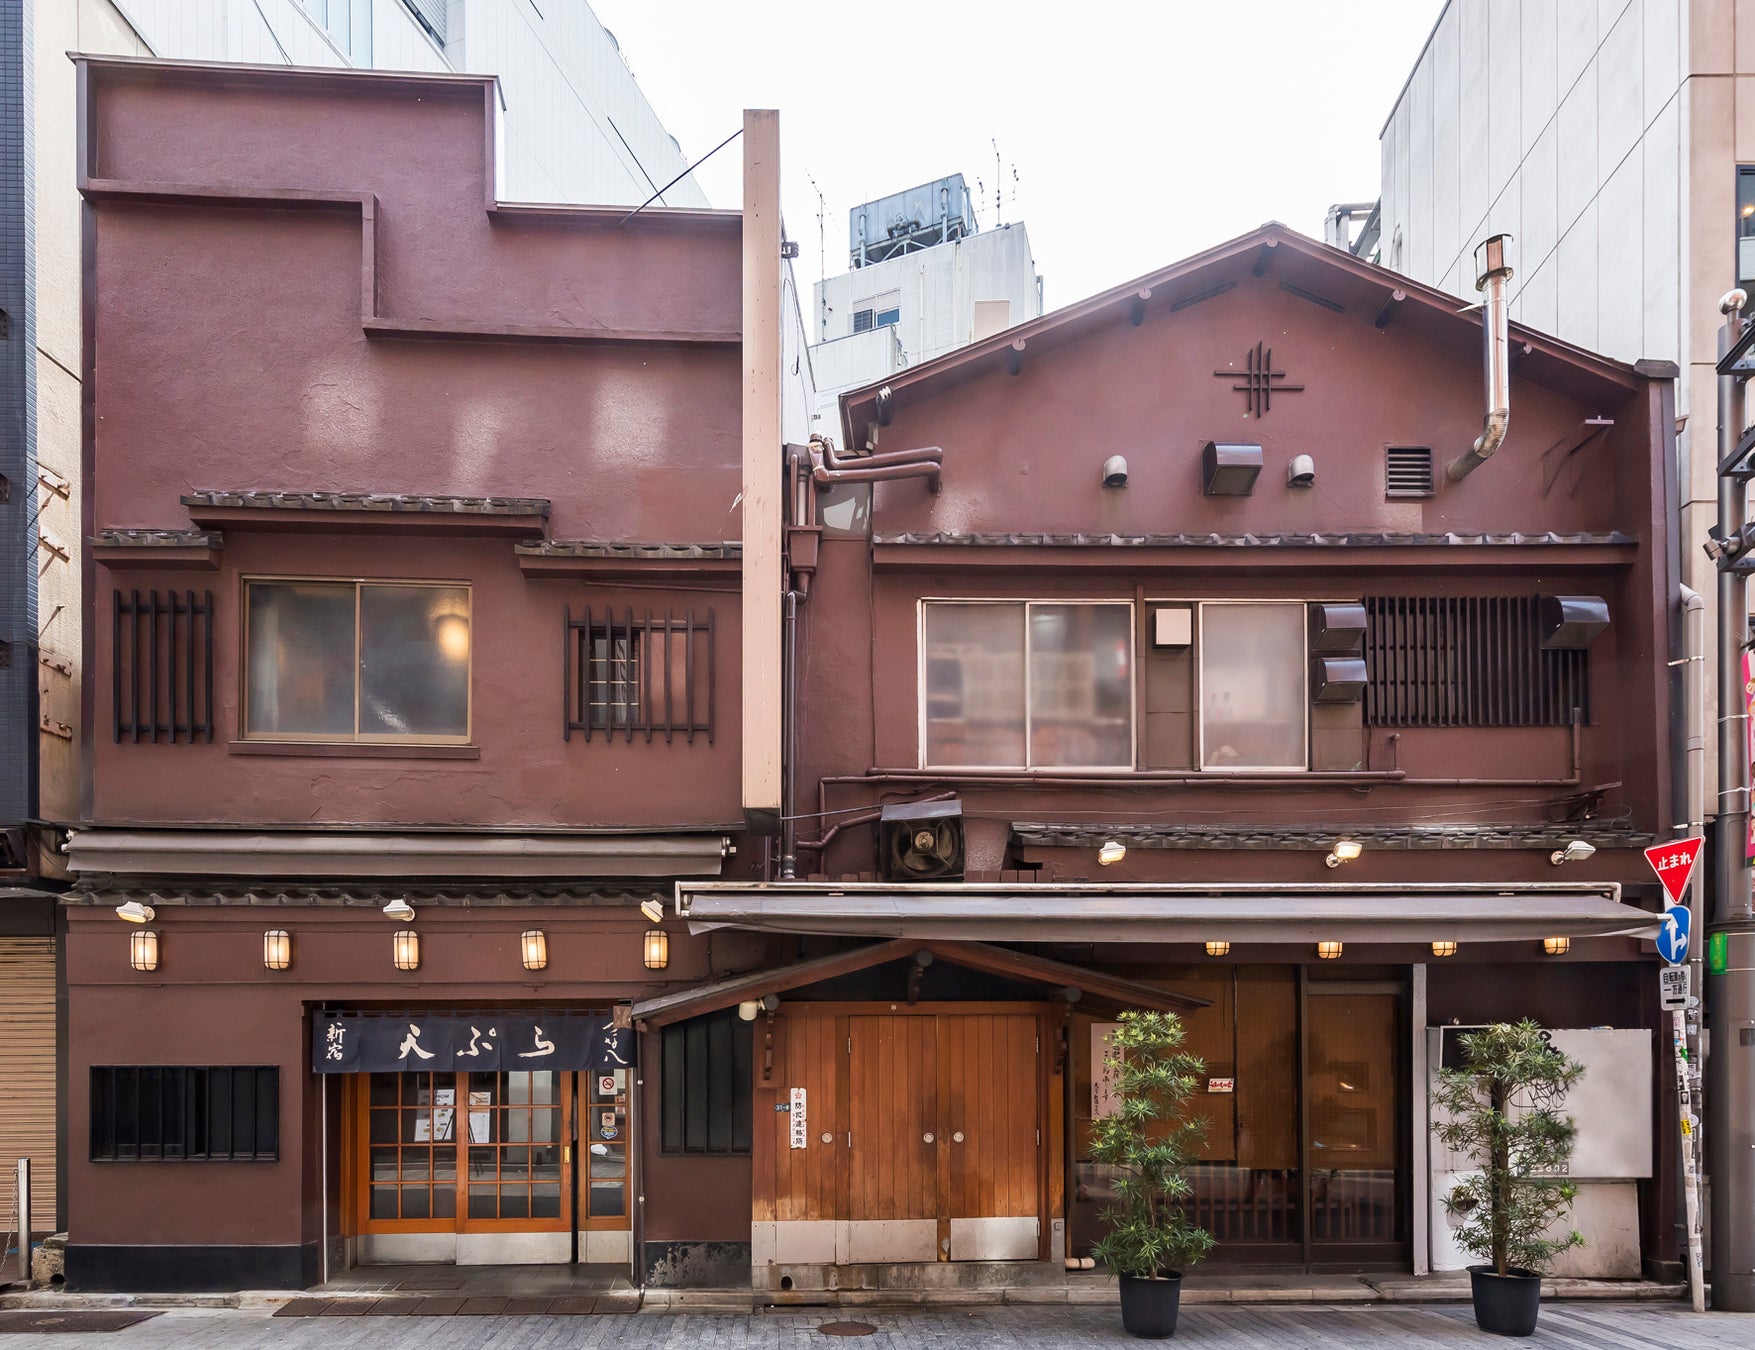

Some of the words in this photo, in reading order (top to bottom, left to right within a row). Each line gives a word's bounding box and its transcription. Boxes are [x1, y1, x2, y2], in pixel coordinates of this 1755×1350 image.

[1657, 851, 1692, 871] 止まれ
[1663, 983, 1688, 995] 一方通行
[326, 1021, 346, 1060] 新宿
[398, 1022, 555, 1060] 天ぷら
[794, 1101, 803, 1146] 防犯連絡所
